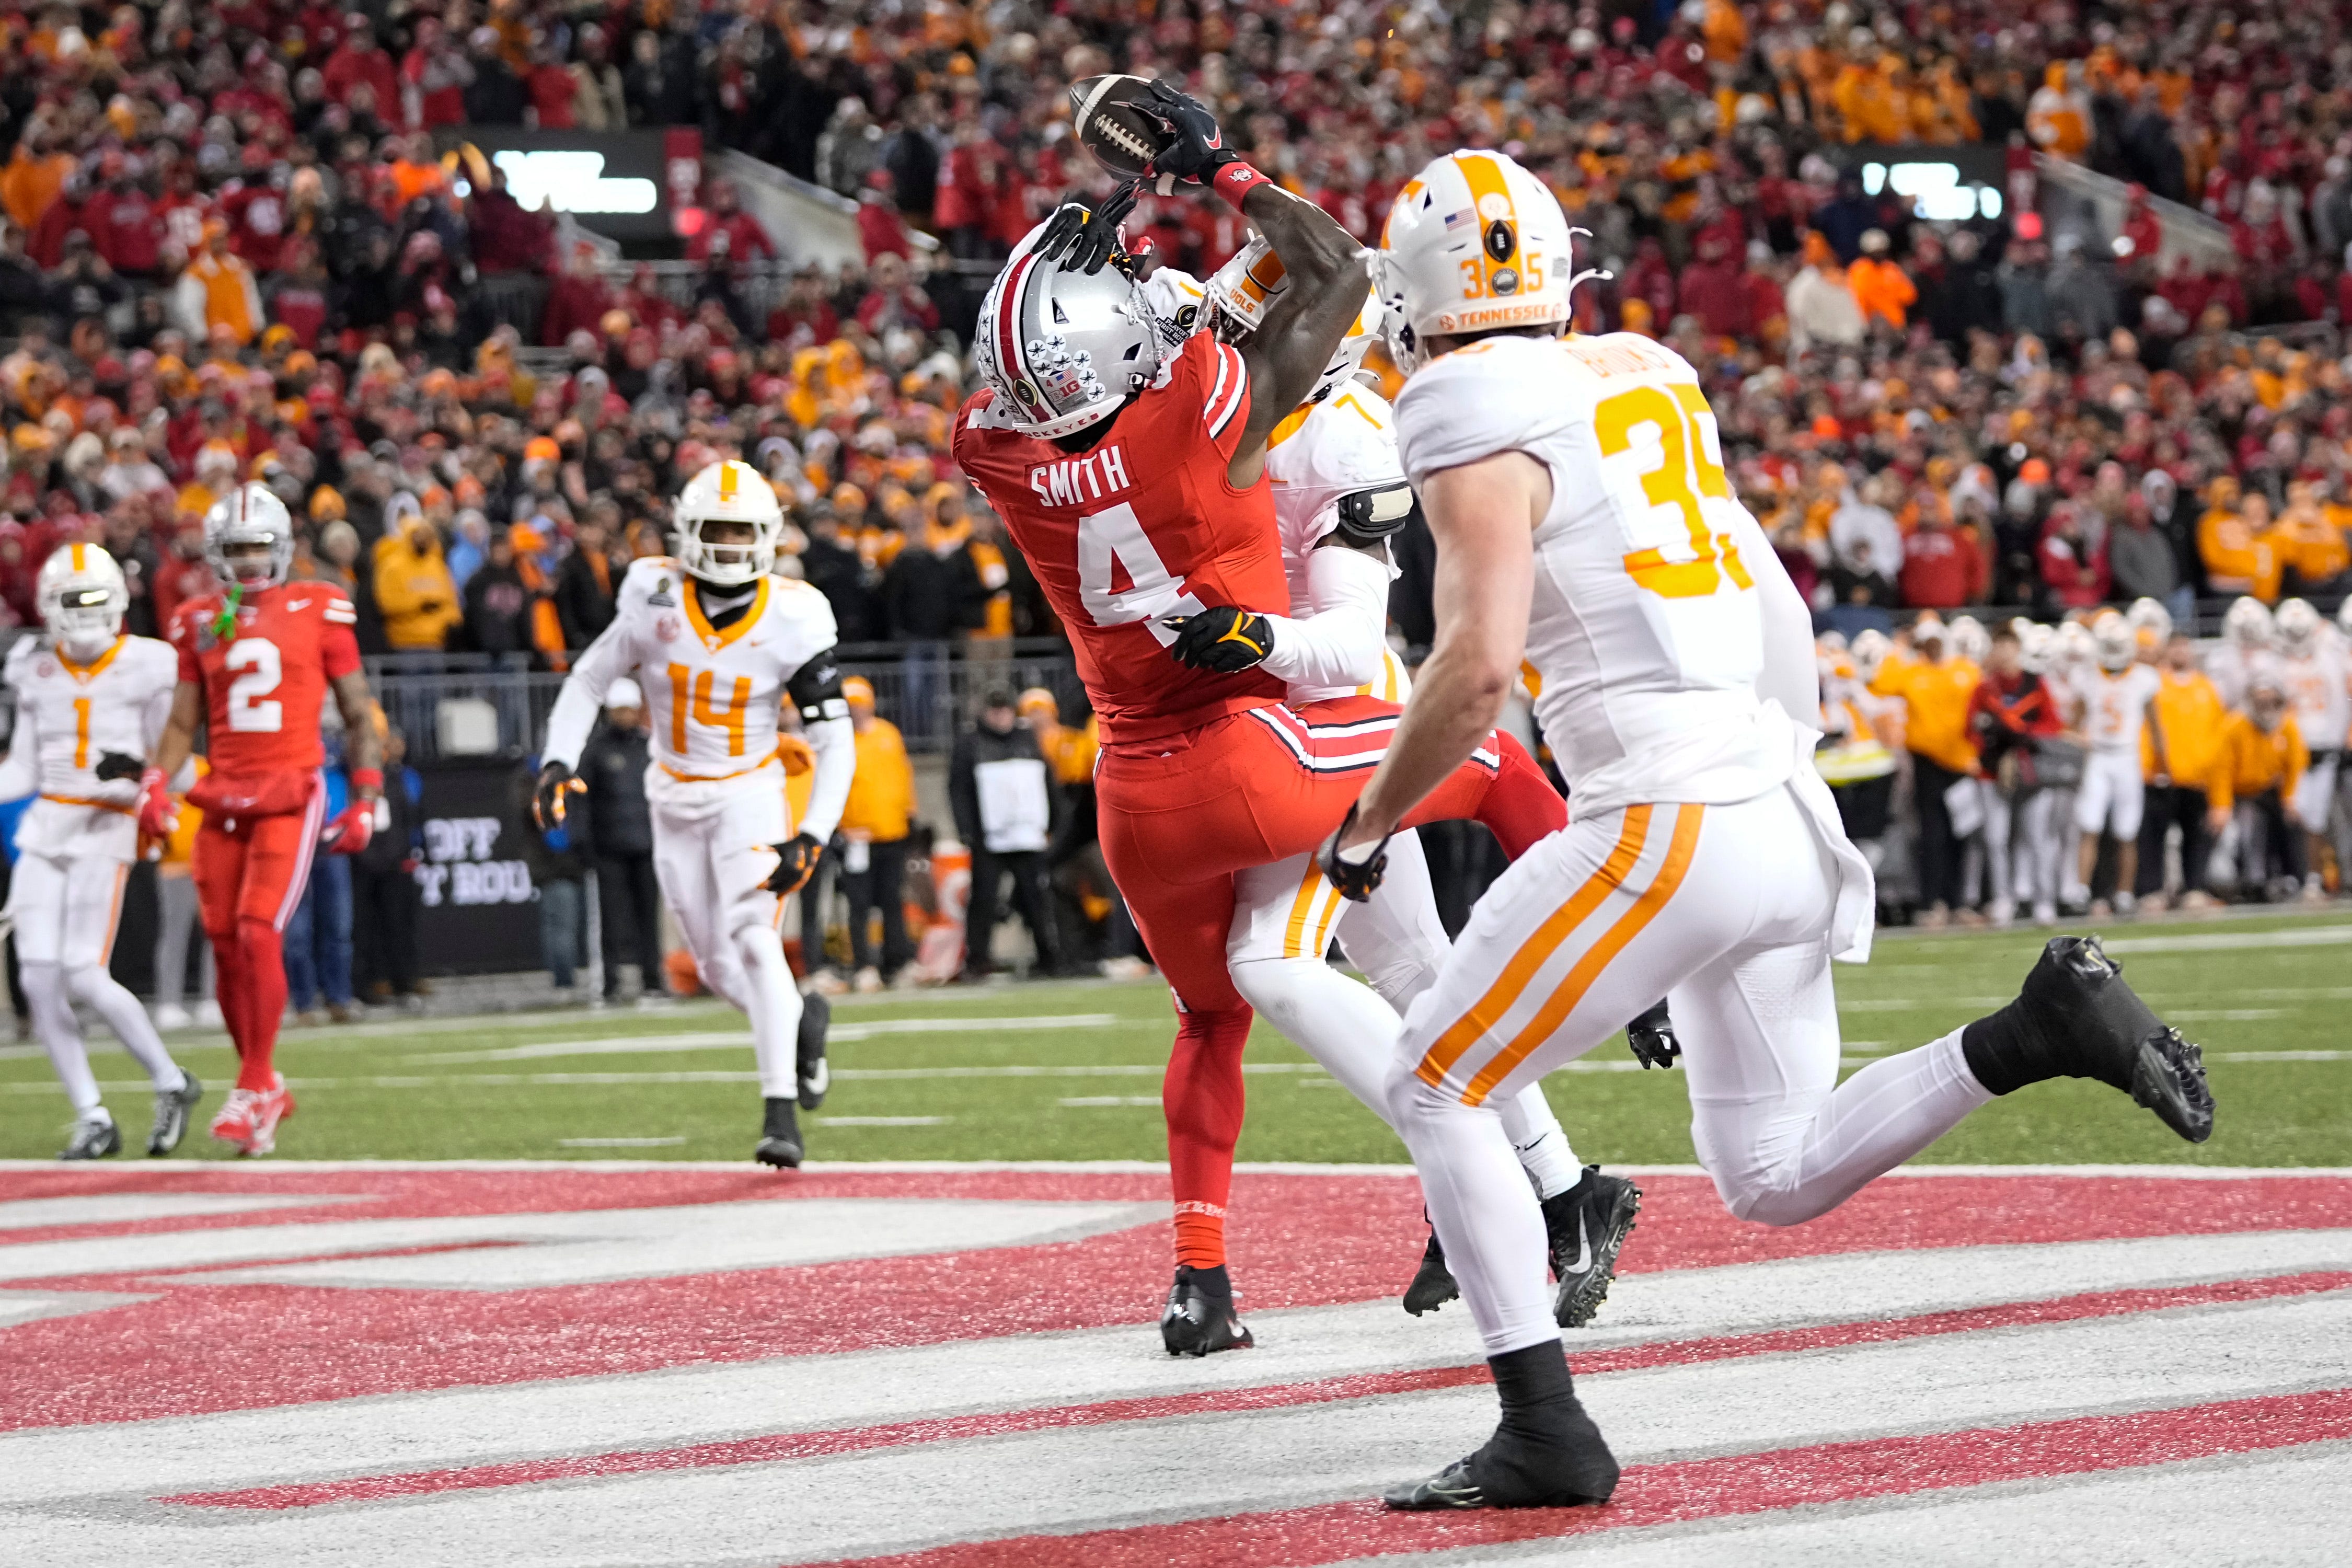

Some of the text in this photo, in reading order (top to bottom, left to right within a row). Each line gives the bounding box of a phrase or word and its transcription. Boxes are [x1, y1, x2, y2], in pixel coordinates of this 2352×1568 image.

[1156, 319, 1174, 334] FIRST
[1230, 288, 1257, 314] VOLS
[1460, 304, 1548, 326] TENNESSEE
[1332, 393, 1383, 430] 7
[1031, 445, 1130, 506] SMITH
[1078, 501, 1207, 648] 4
[226, 638, 283, 732] 2
[667, 662, 753, 757] 14
[73, 697, 92, 769] 1
